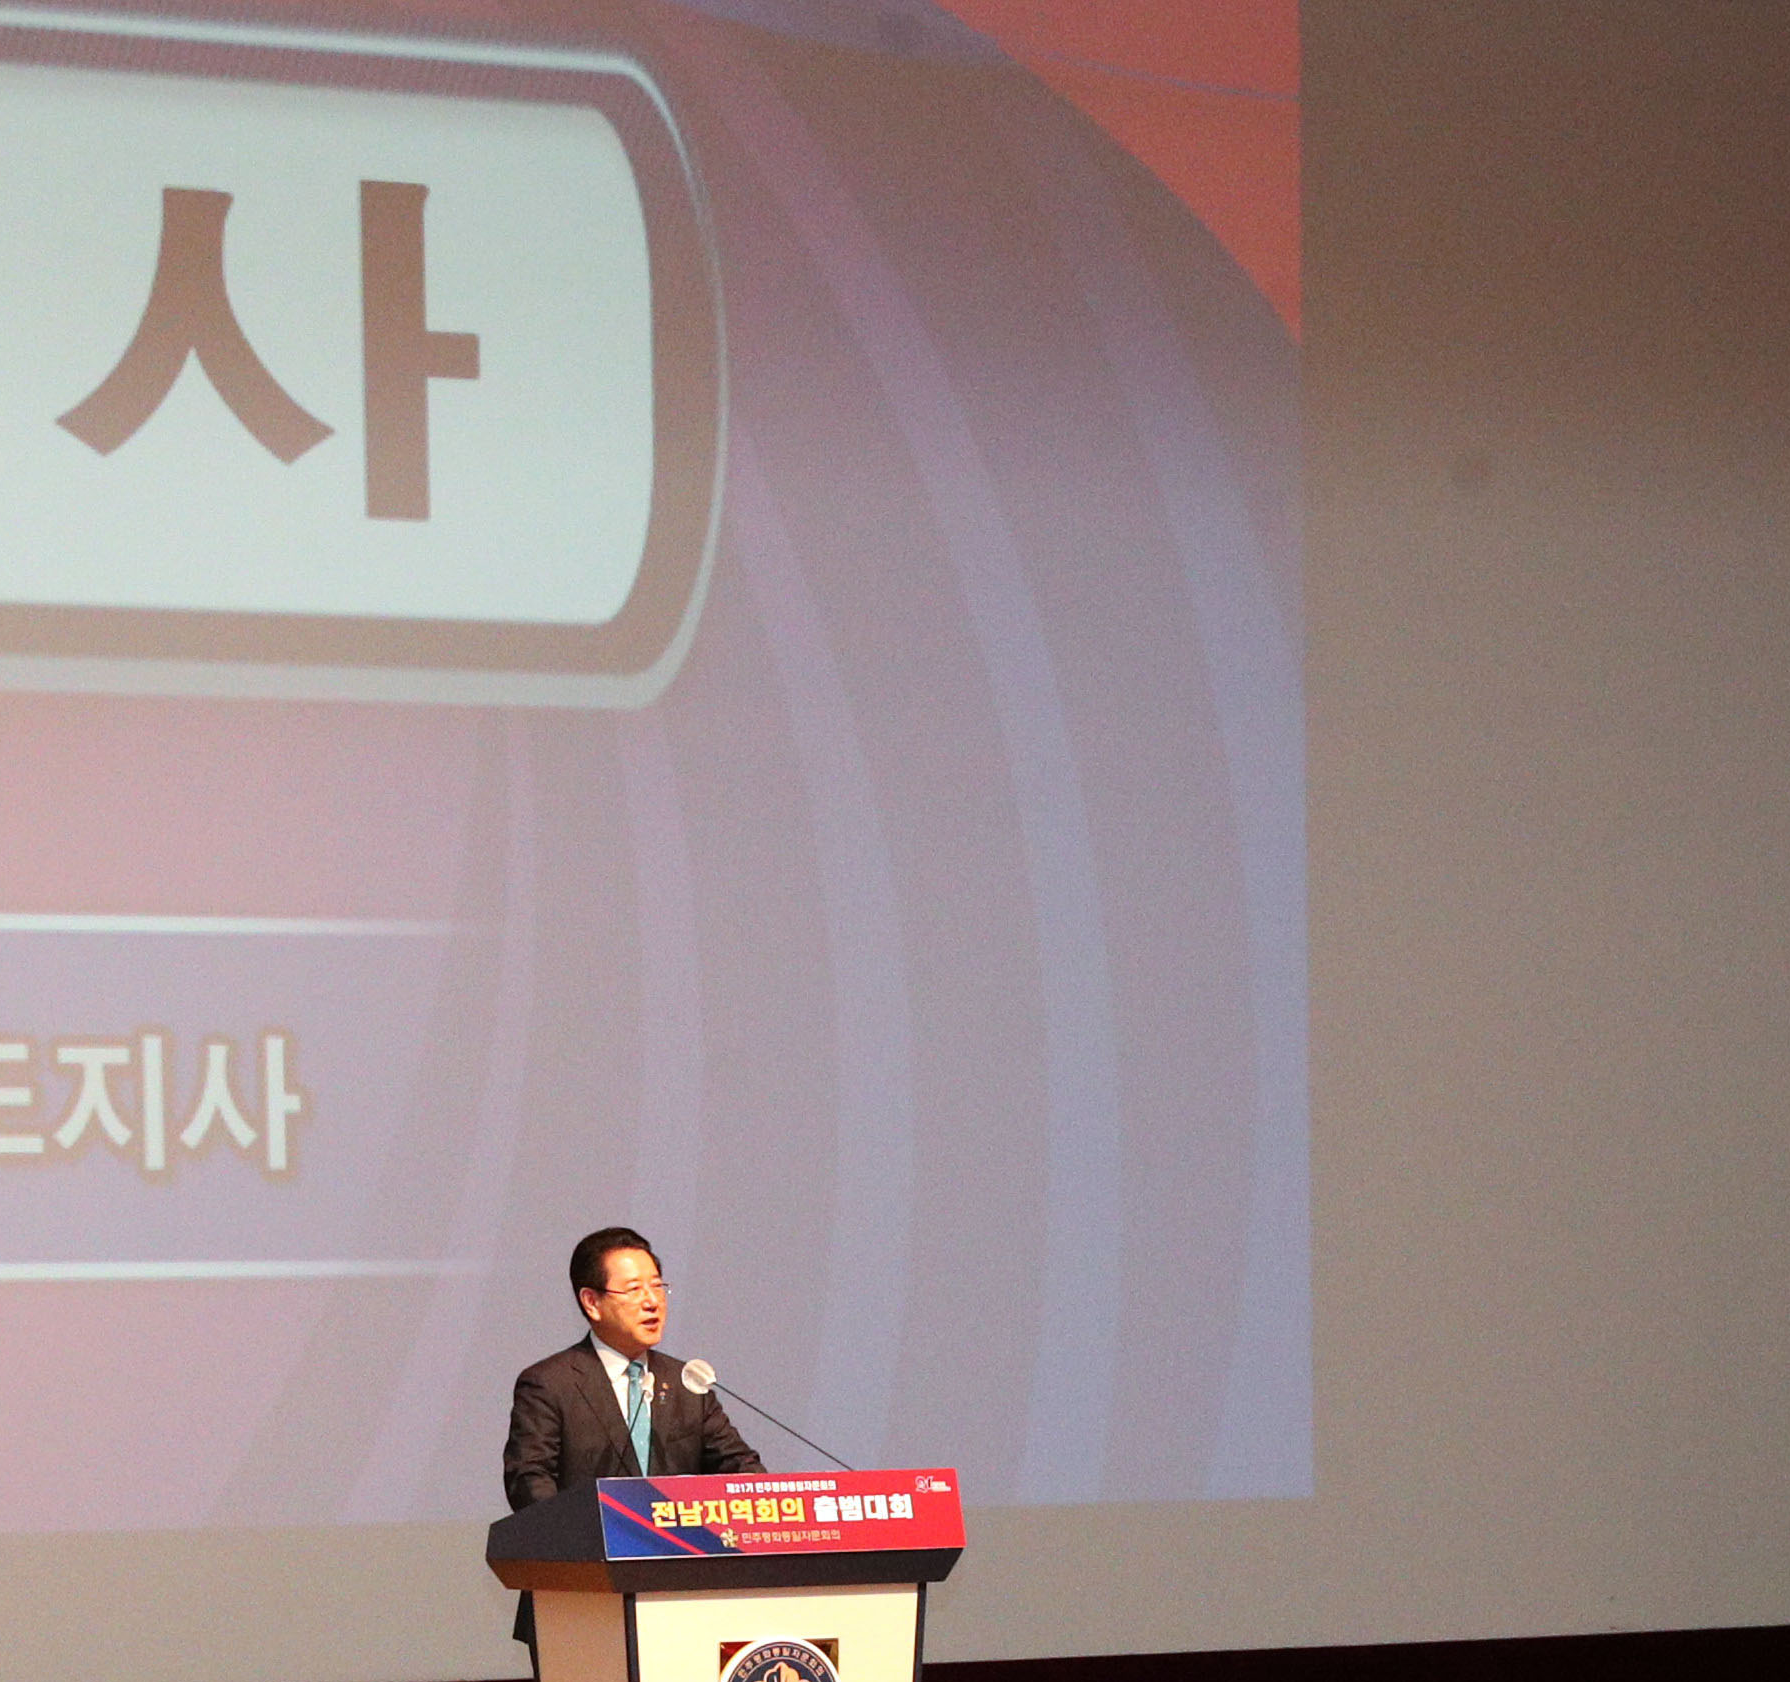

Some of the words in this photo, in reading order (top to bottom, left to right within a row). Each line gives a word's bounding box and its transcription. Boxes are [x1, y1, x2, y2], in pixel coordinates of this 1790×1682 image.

[56, 178, 480, 521] 사
[651, 1497, 806, 1527] 전남지역회의
[814, 1493, 913, 1522] 출범대회
